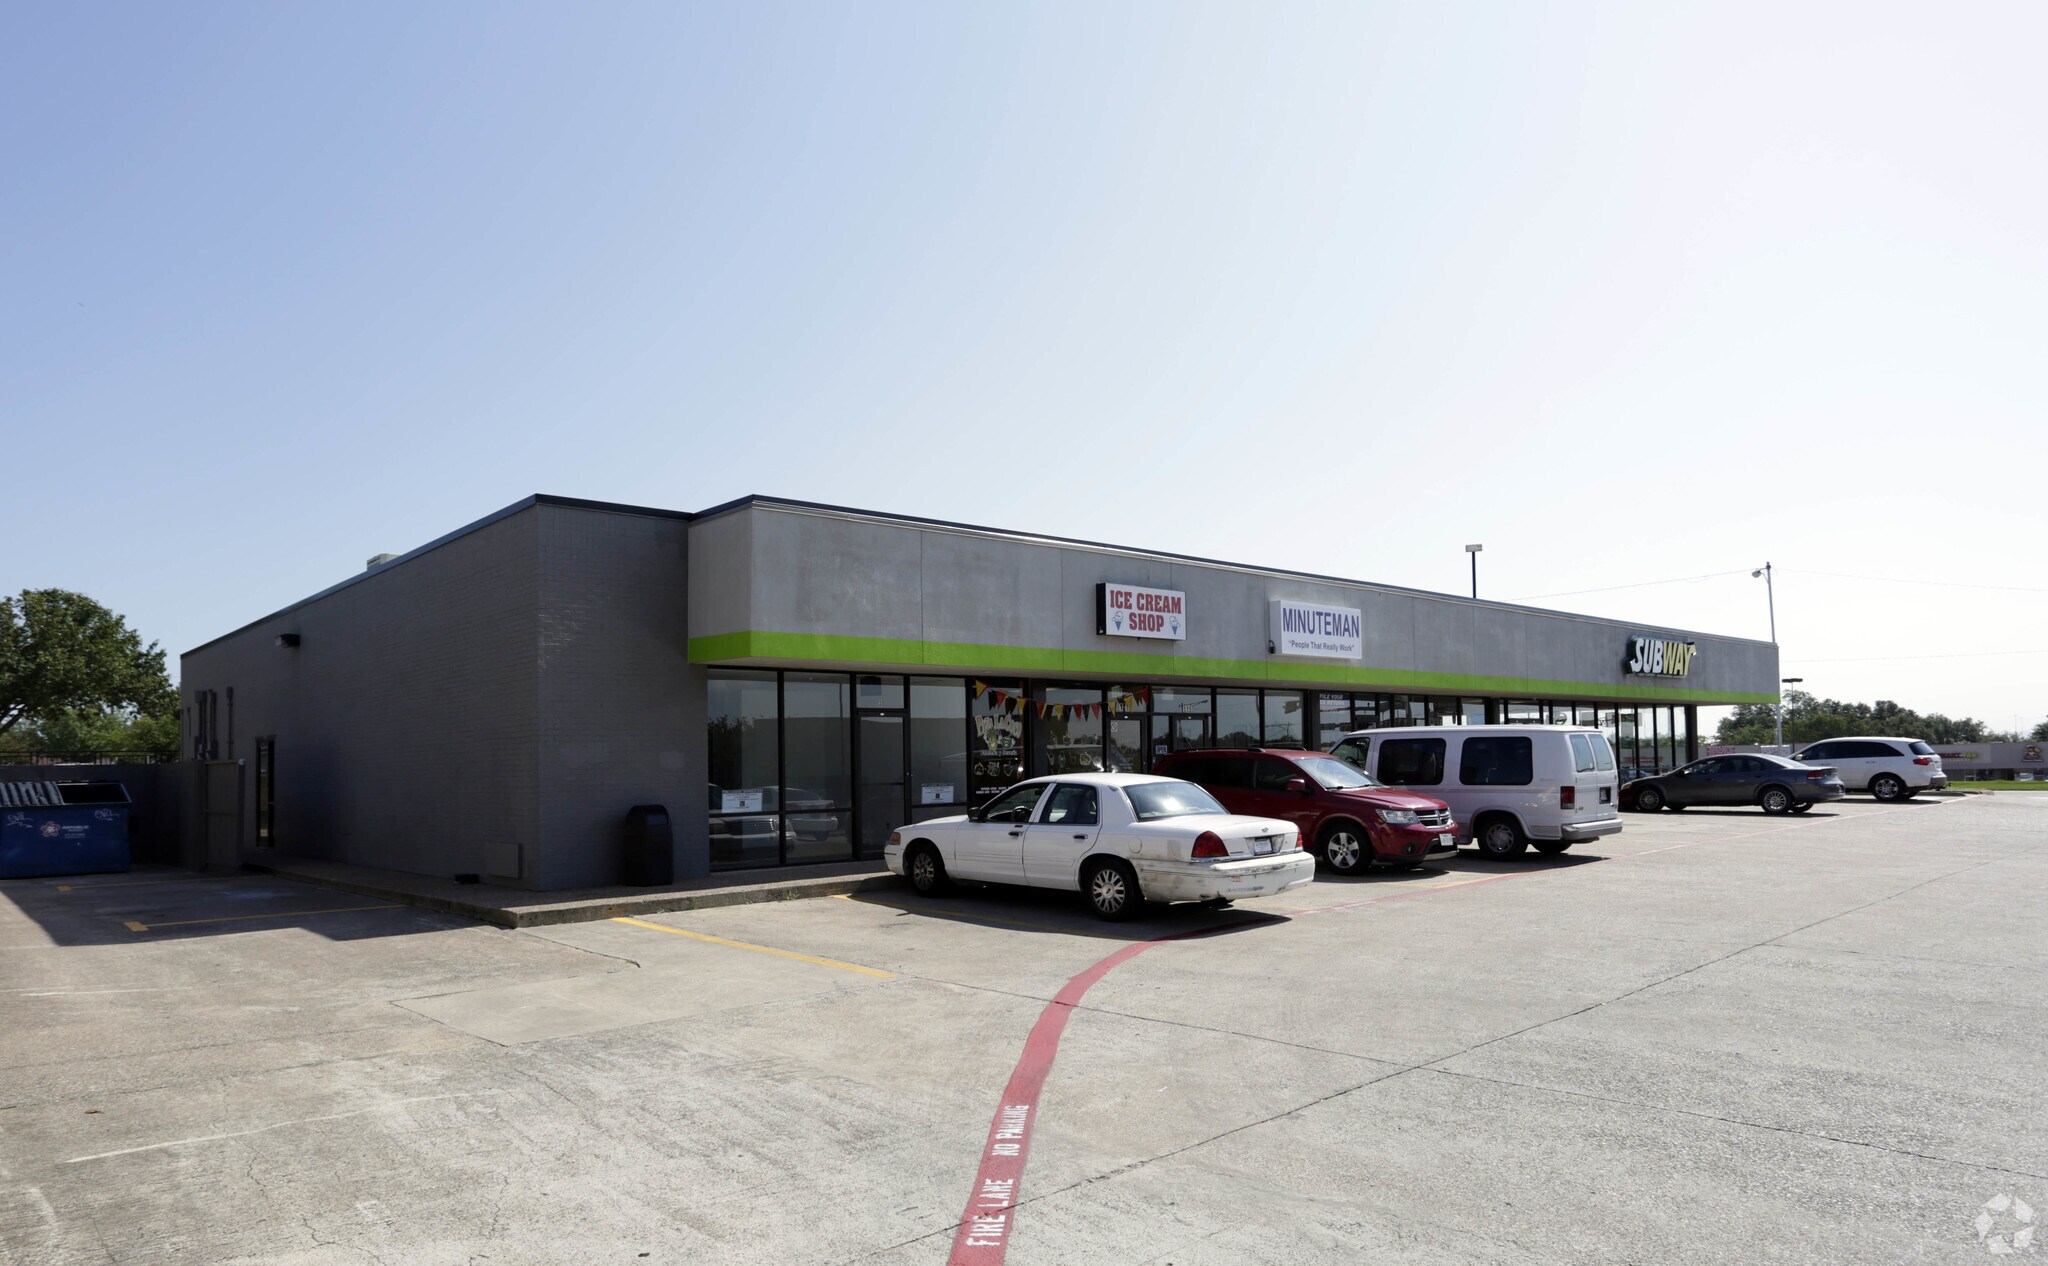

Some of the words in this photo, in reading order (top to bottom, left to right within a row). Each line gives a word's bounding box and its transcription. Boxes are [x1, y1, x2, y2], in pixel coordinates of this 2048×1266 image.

[1110, 590, 1132, 609] ICE
[1137, 593, 1181, 614] CREAM
[1129, 612, 1164, 632] SHOP
[1282, 607, 1359, 638] MINUTEMAN
[1310, 642, 1322, 650] That
[1323, 642, 1338, 652] Really
[1630, 638, 1696, 676] SUBWAY
[995, 1105, 1030, 1139] PARKING
[991, 1143, 1021, 1156] NO
[977, 1178, 1013, 1207] LANE
[966, 1215, 1006, 1246] FIRE
